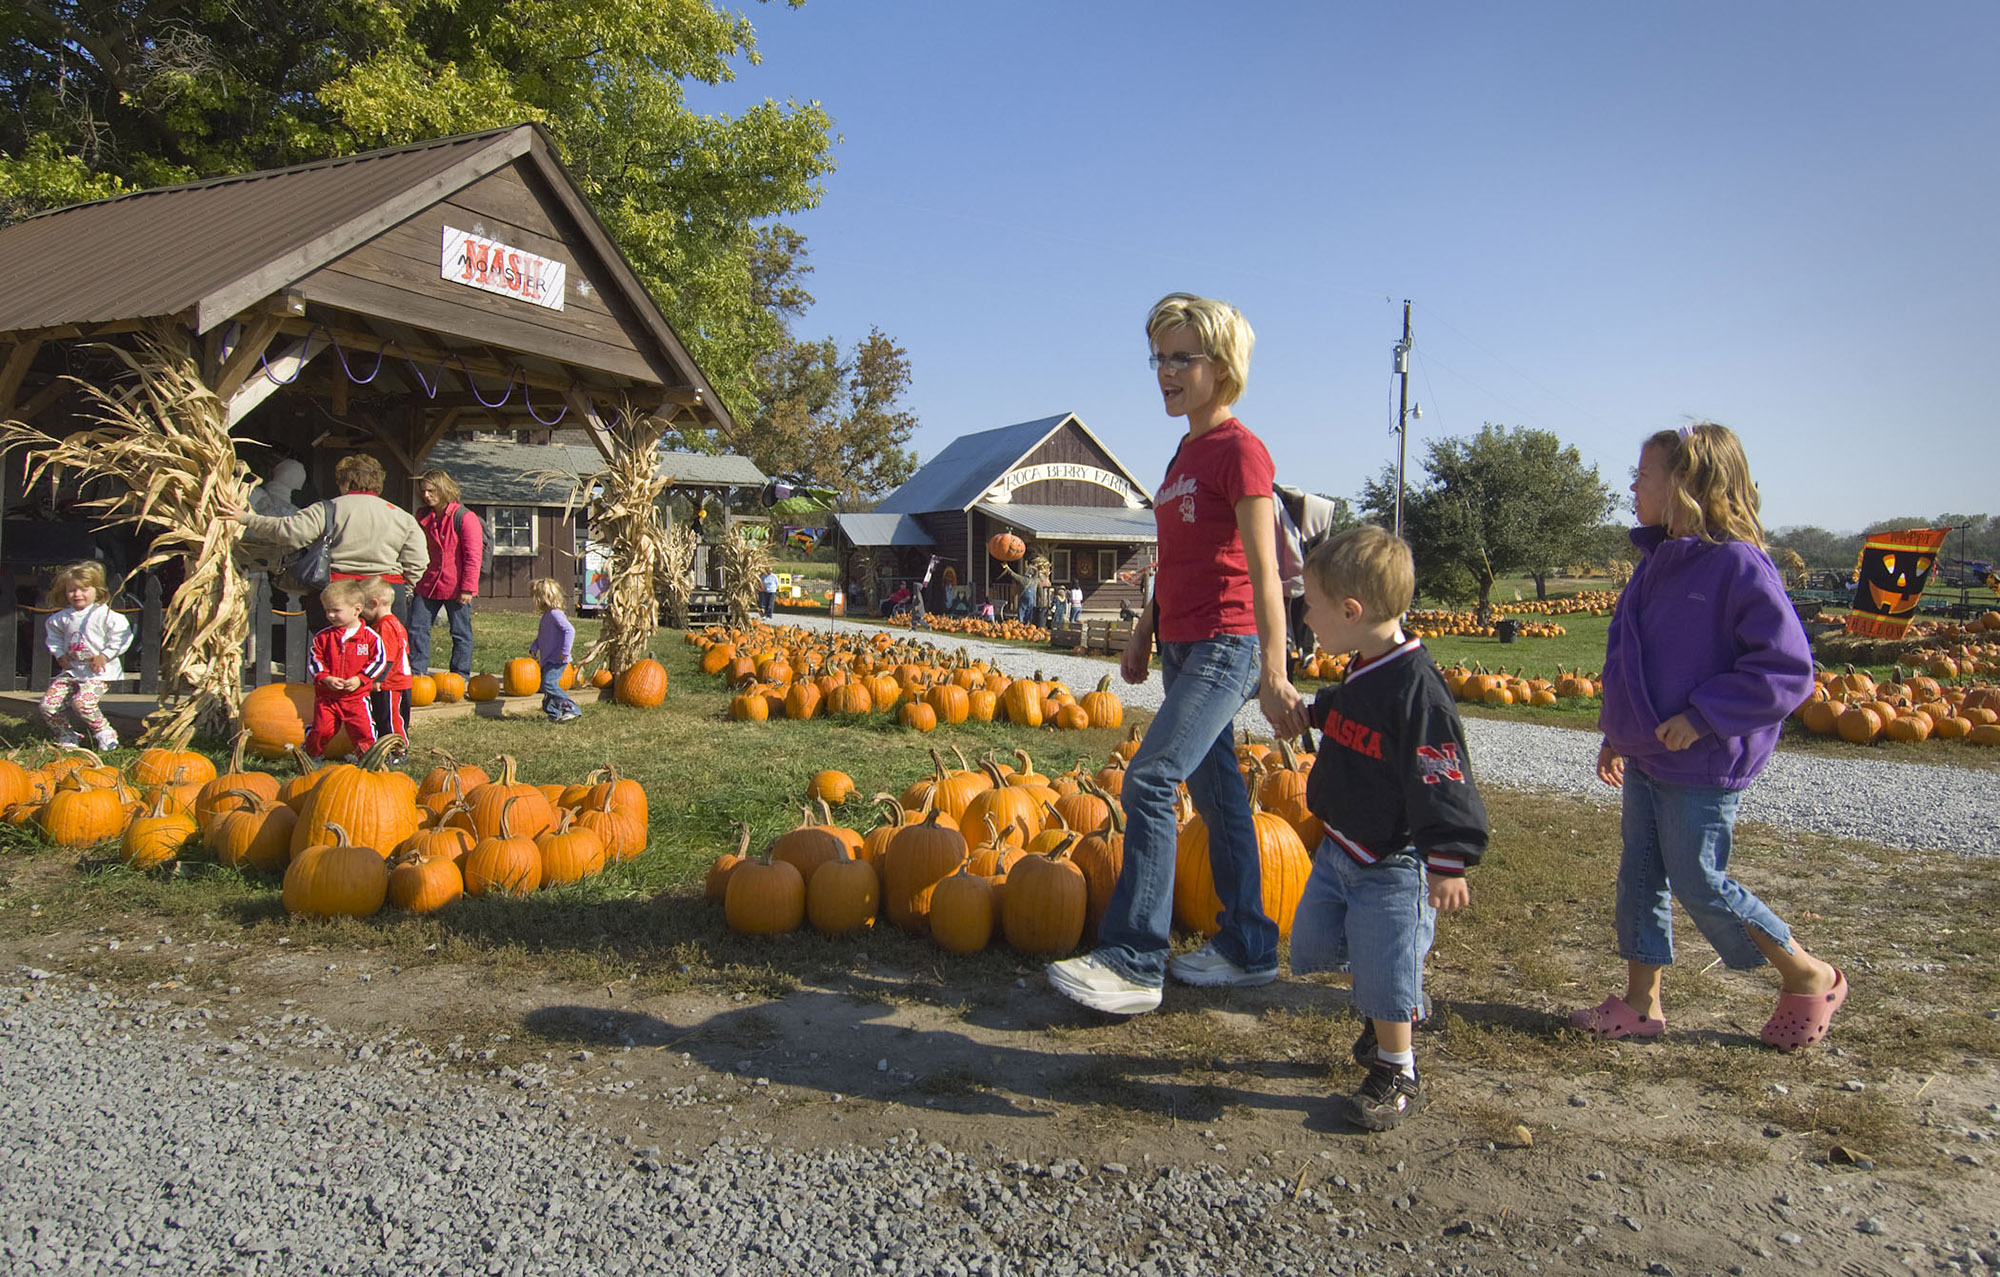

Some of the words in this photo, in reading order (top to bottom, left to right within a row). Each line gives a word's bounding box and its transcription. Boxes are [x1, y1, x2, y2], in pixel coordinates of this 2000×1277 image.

[457, 254, 546, 292] MONSTER
[461, 240, 542, 299] MASH
[1006, 467, 1041, 491] ROCA
[1047, 465, 1088, 478] BERRY
[1094, 471, 1129, 496] FARM
